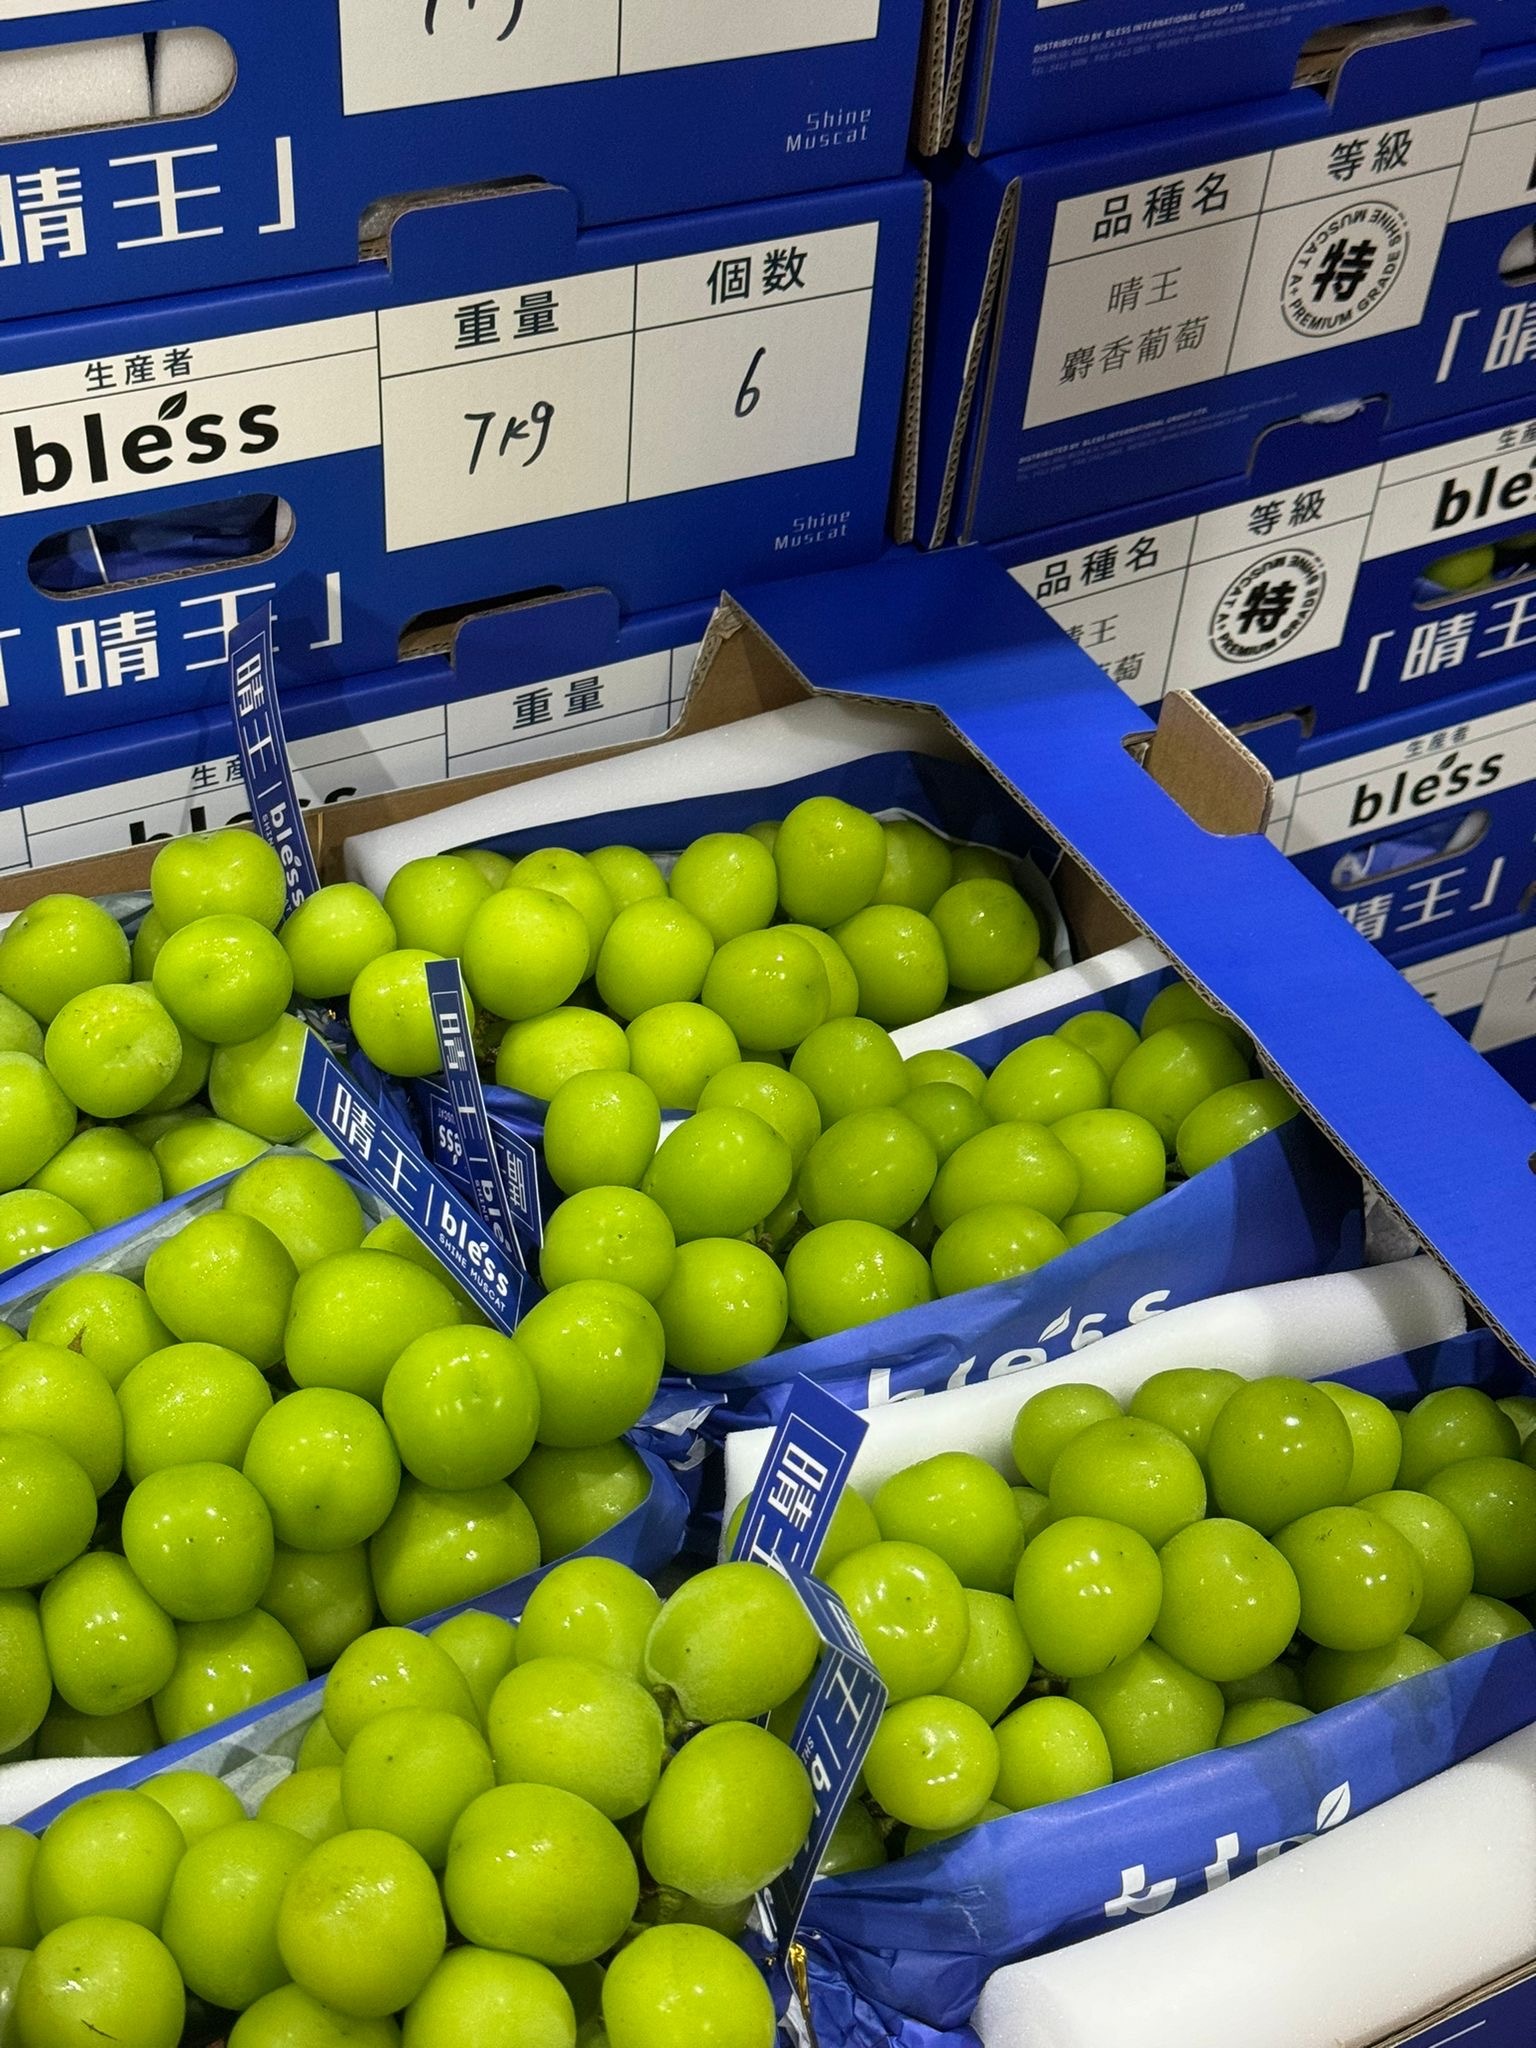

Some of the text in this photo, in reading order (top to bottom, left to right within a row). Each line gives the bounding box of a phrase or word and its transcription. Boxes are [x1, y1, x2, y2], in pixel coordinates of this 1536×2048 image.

[786, 125, 867, 152] Muscat
[806, 108, 872, 131] Shine
[1327, 129, 1413, 182] 等級
[1092, 171, 1229, 243] 品種名
[706, 246, 808, 306] 個数
[1107, 266, 1182, 314] 晴王
[1311, 238, 1379, 302] 特
[454, 290, 560, 351] 重量
[1058, 315, 1210, 386] 麝香葡萄
[85, 347, 194, 392] 生産者
[733, 347, 767, 418] 6
[14, 391, 279, 496] bless
[792, 511, 851, 533] Shine
[1248, 488, 1327, 537] 等級
[1431, 460, 1536, 531] ble
[774, 524, 847, 551] Muscat
[1036, 536, 1159, 600] 品種名
[1236, 580, 1298, 634] 特
[235, 652, 279, 780] 晴王
[511, 675, 605, 731] 重量
[1348, 752, 1504, 828] bless
[261, 813, 275, 847] SHIN
[270, 801, 306, 909] bless
[438, 1012, 485, 1140] 晴王
[330, 1083, 421, 1211] 晴王
[438, 1233, 507, 1313] SHINE MUSCAT
[439, 1200, 509, 1298] bless
